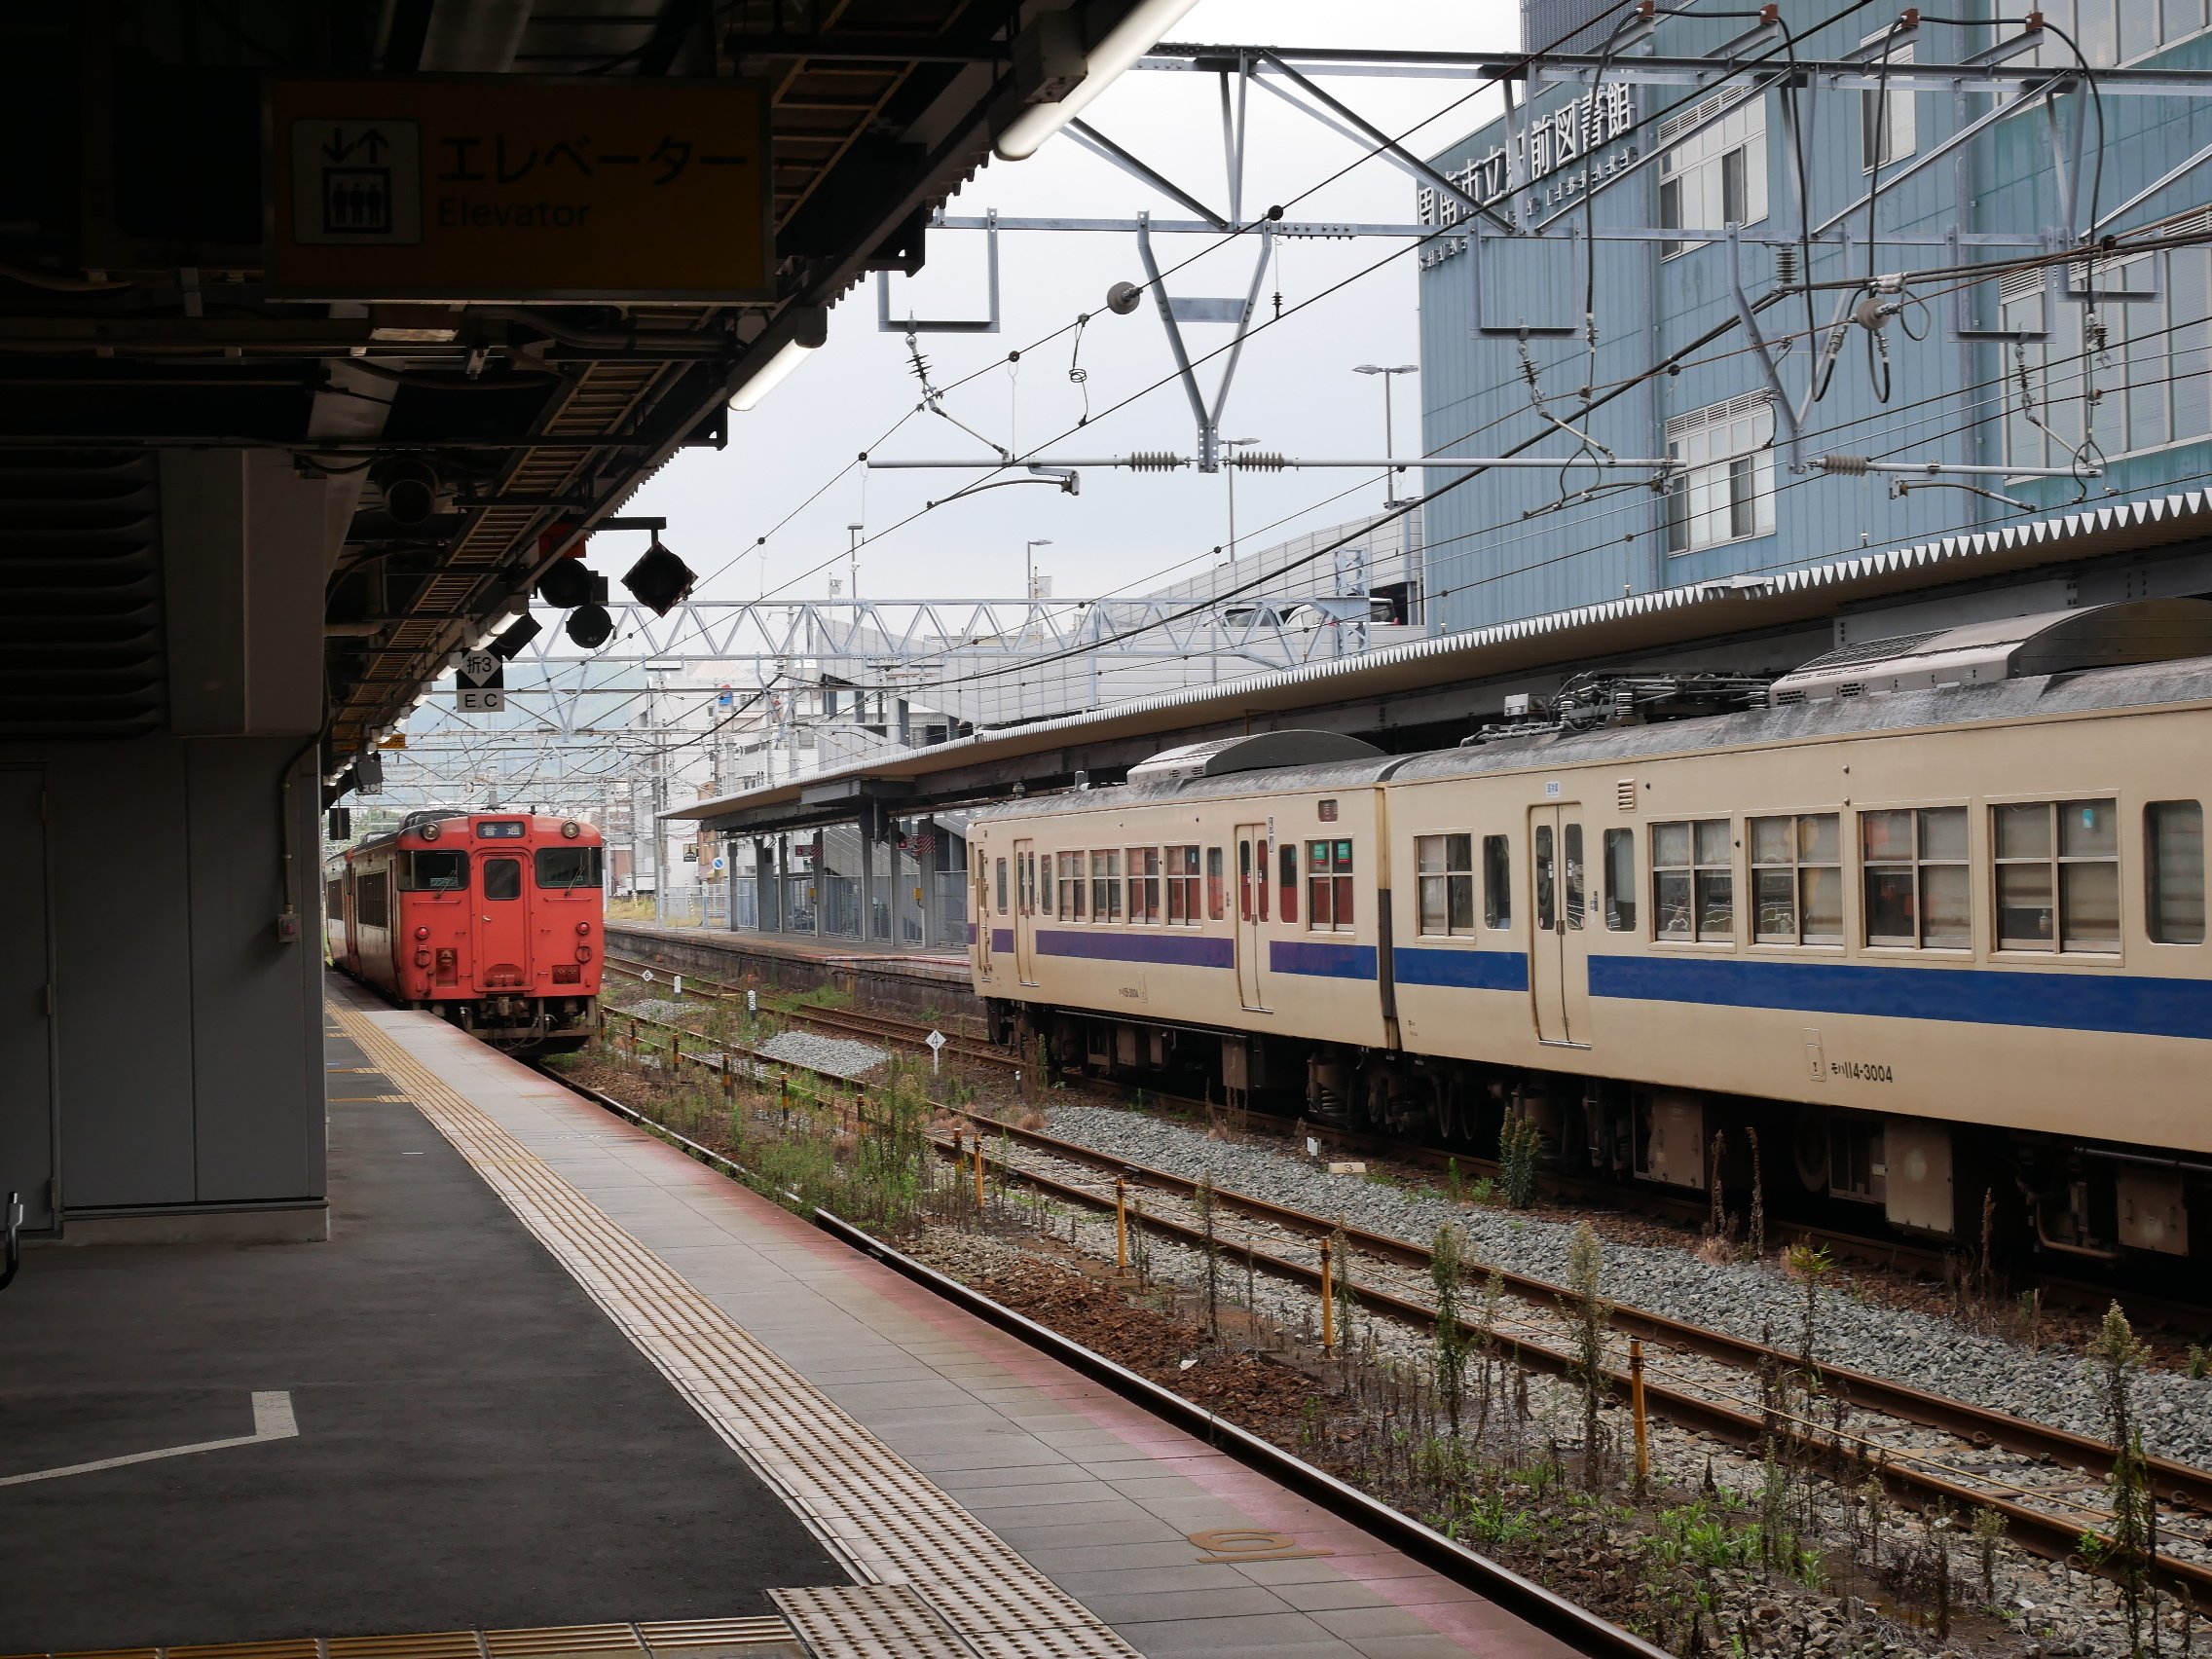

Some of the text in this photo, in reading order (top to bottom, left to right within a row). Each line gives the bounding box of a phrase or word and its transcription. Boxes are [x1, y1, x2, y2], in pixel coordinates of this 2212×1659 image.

[436, 132, 749, 187] エレベーター
[1546, 147, 1638, 206] LIBRARY
[437, 196, 592, 229] Elevator
